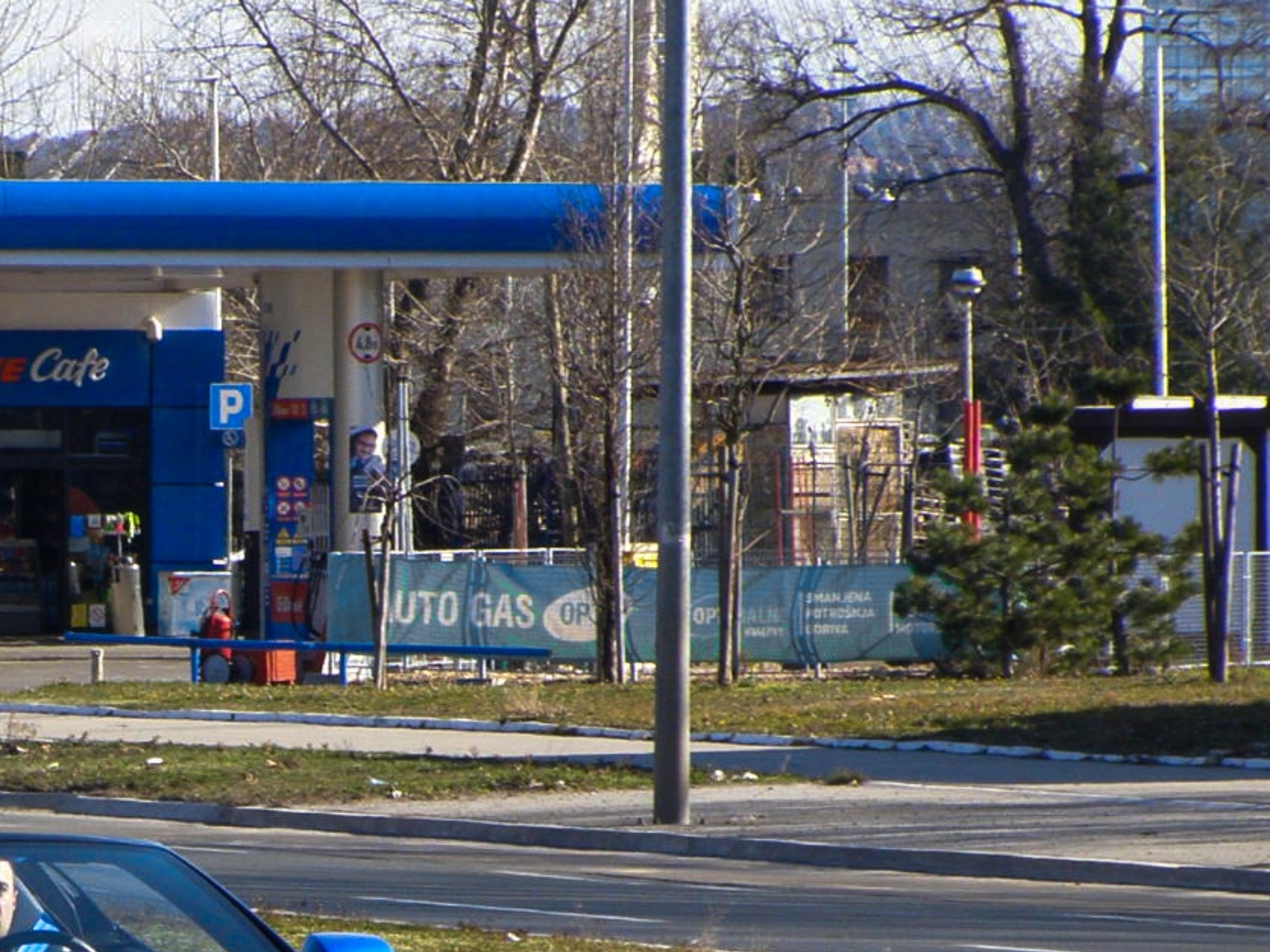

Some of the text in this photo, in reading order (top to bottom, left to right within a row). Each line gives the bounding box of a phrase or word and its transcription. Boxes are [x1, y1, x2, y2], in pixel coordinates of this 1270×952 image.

[31, 348, 110, 387] Cafe
[220, 390, 244, 424] P
[389, 590, 591, 629] UTO GAS OP
